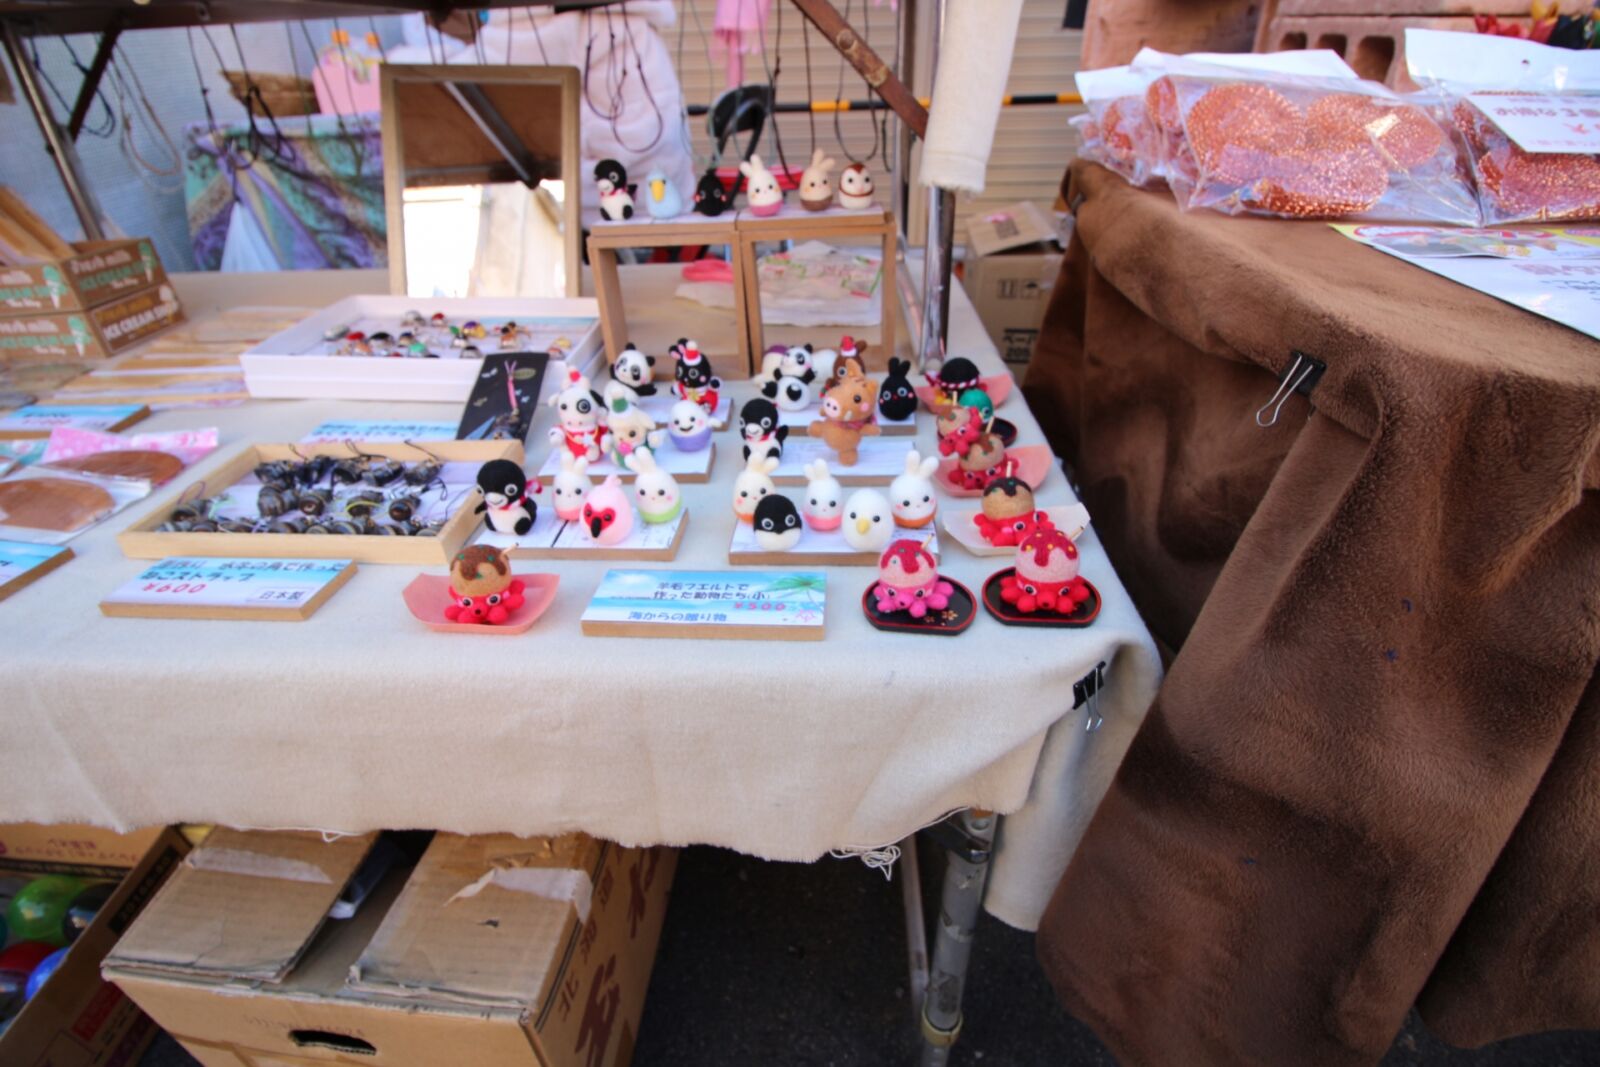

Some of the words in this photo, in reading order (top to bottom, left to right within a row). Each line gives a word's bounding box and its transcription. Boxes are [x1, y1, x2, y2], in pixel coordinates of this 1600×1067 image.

[142, 583, 207, 594] ¥600
[259, 590, 306, 601] 日本製
[627, 611, 728, 622] 海からの贈り物
